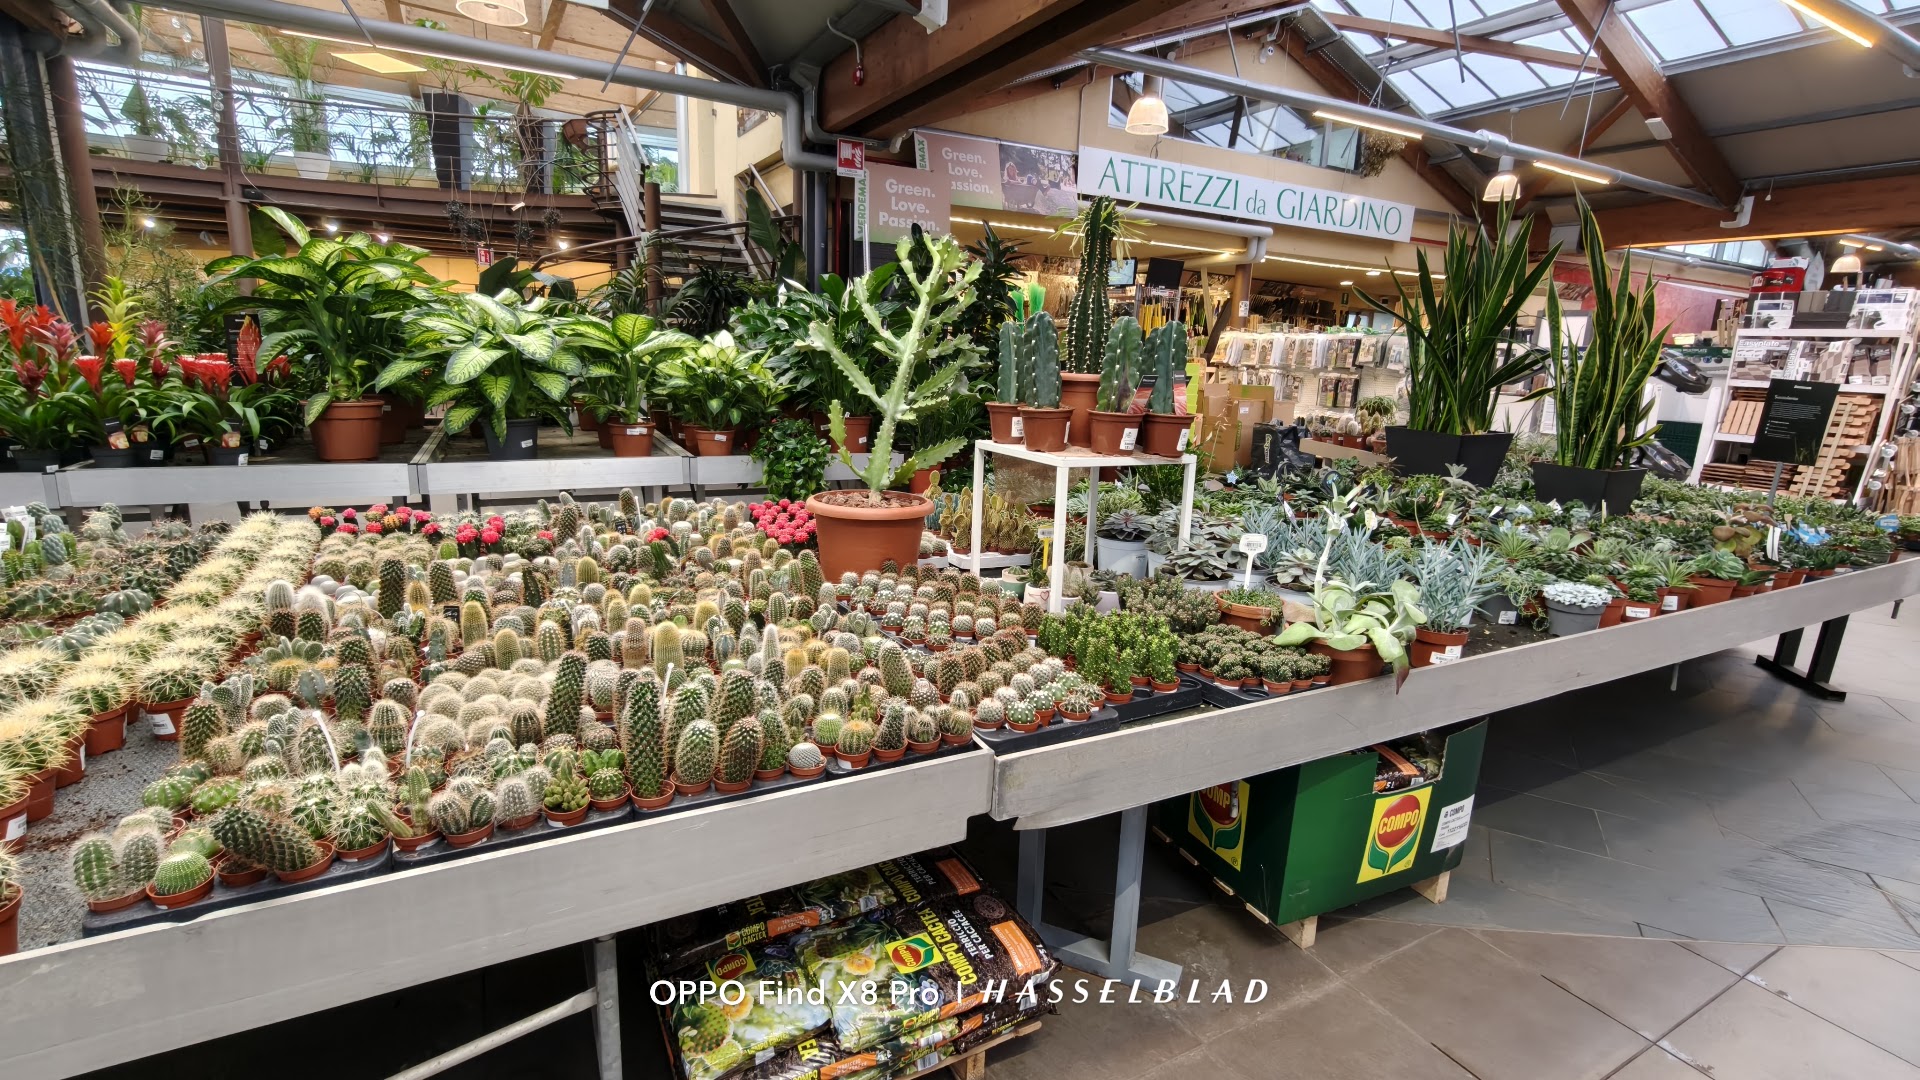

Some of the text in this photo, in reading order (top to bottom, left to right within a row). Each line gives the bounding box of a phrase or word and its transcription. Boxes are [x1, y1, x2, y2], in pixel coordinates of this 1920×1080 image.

[917, 138, 927, 168] EMAX
[942, 147, 987, 164] Green.
[948, 162, 983, 178] Love.
[885, 179, 936, 198] Green.
[951, 179, 994, 194] assion.
[1098, 156, 1402, 236] ATTREZZI da GIARDINO
[857, 171, 867, 234] VERDEMA
[891, 196, 930, 214] Love.
[1201, 786, 1231, 808] OMP
[1379, 809, 1419, 834] COMPO
[878, 862, 921, 903] COMPO CAC
[924, 874, 937, 885] PER
[741, 922, 765, 937] COMPO
[917, 907, 952, 942] CACTEA
[952, 909, 982, 945] CACTACEE
[742, 931, 767, 945] CACTEA
[947, 918, 979, 957] TERRICCIO
[898, 945, 917, 967] COMPO
[941, 939, 978, 985] COMPO
[976, 945, 994, 960] PER
[717, 956, 747, 976] COMPO
